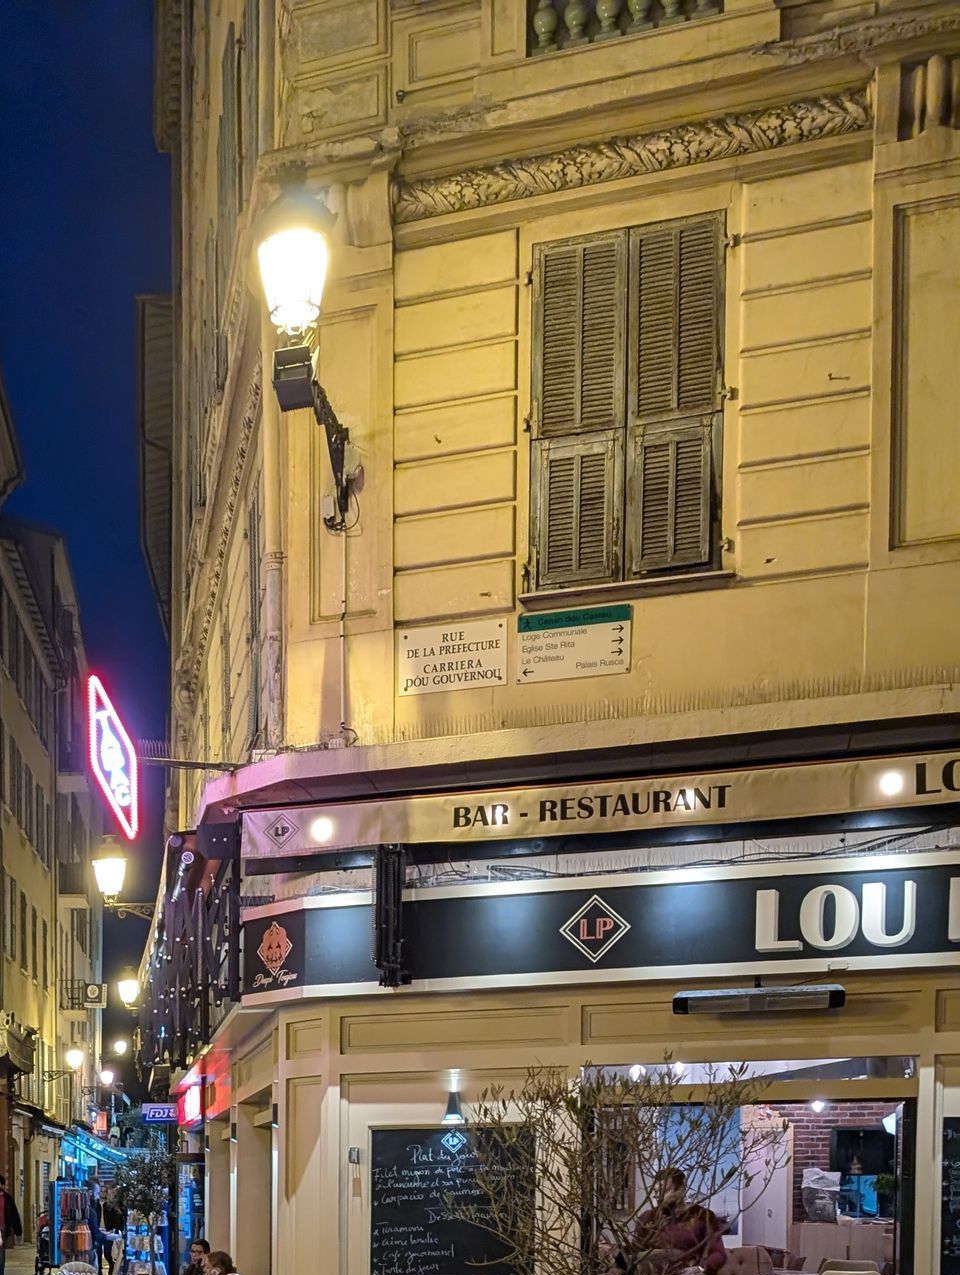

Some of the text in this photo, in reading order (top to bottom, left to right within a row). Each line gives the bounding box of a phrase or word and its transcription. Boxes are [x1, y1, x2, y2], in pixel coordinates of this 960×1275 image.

[442, 631, 464, 643] RUE
[522, 627, 588, 642] Loge Communale
[407, 639, 500, 659] DE LA PREFECTURE
[522, 640, 575, 654] Eglise Ste Rita
[423, 659, 482, 674] CARRIERA
[533, 654, 565, 664] Château
[576, 658, 624, 669] Palais Rusca
[95, 710, 131, 806] TABAC
[453, 804, 509, 828] BAR
[539, 784, 732, 822] RESTAURANT
[274, 826, 289, 837] LP
[755, 880, 916, 953] LOU
[579, 917, 614, 942] LP
[149, 1109, 169, 1118] FDJ
[407, 1144, 434, 1164] Plat
